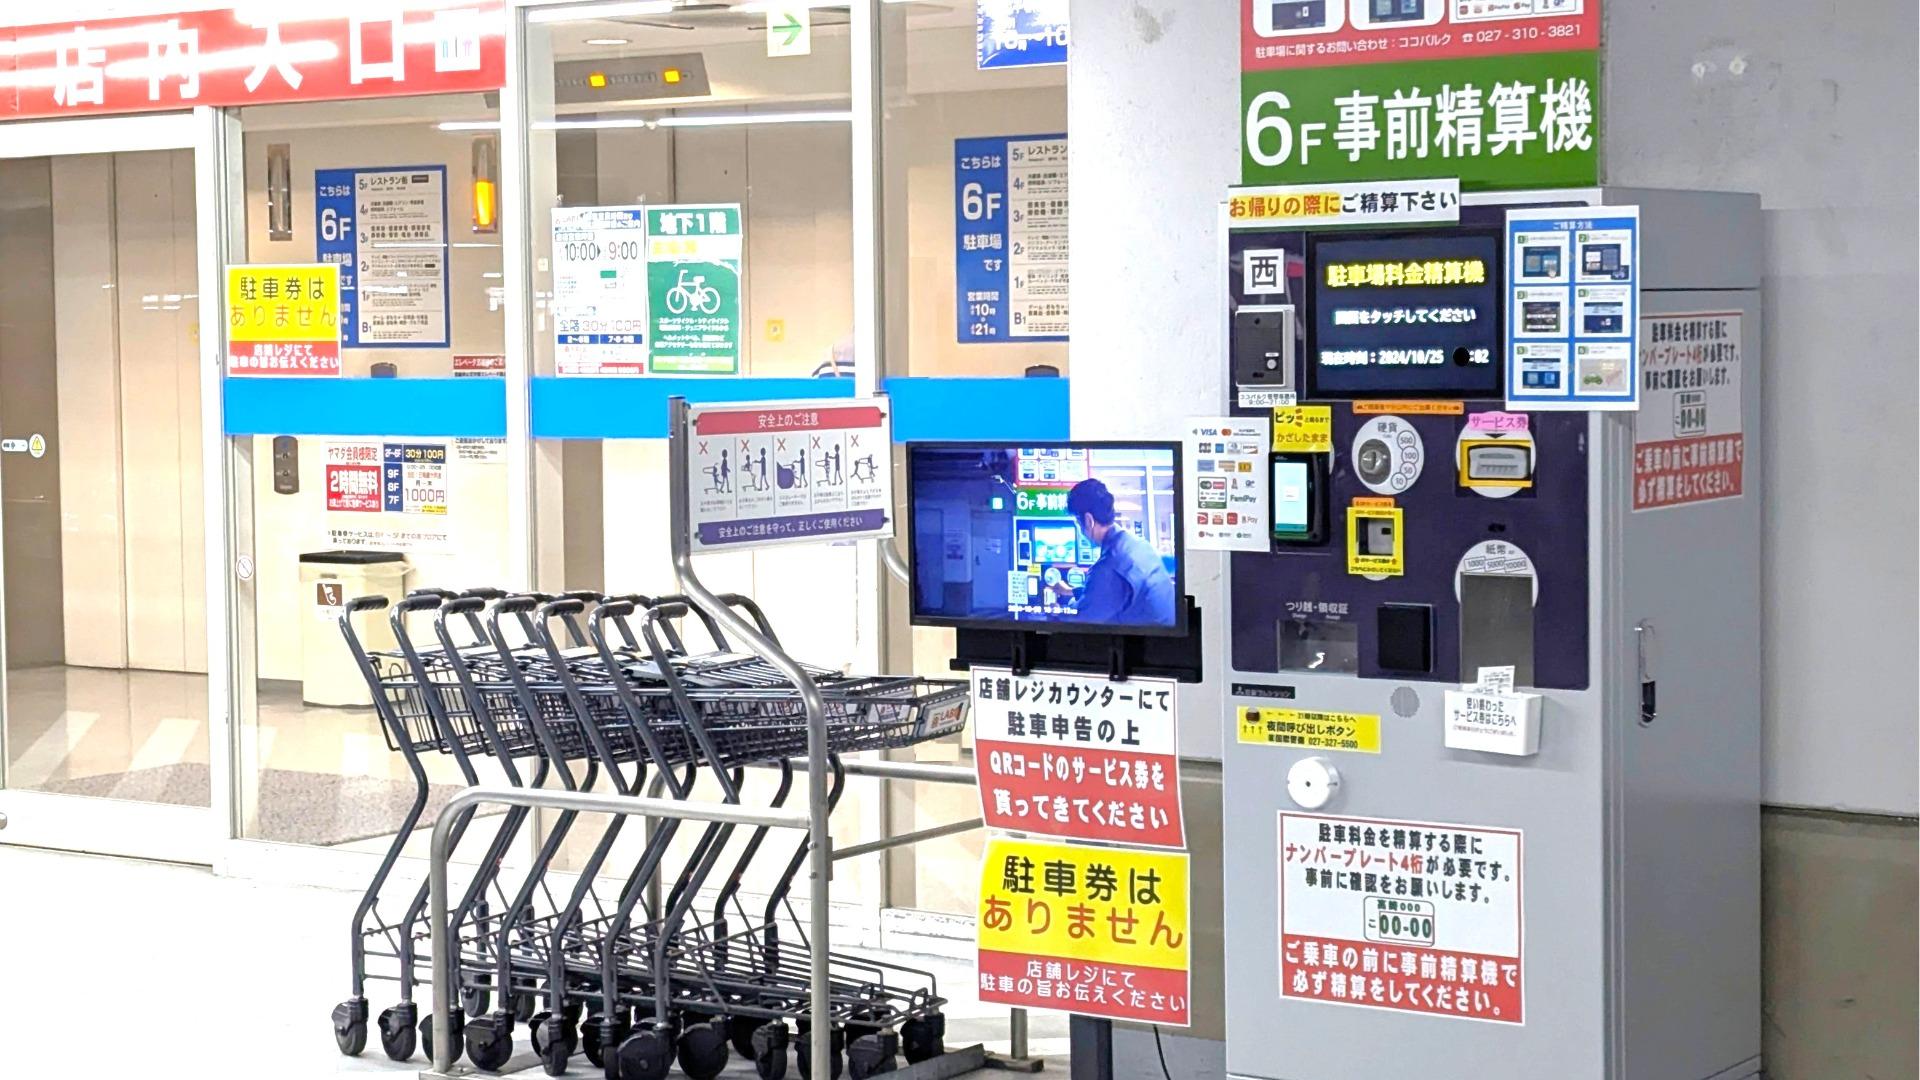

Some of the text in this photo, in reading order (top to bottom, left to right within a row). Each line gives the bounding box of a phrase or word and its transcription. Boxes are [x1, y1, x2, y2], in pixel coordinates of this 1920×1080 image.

[53, 16, 405, 107] 店内入口
[961, 156, 1002, 170] こちらは
[1012, 147, 1025, 161] 5F
[319, 185, 351, 197] こちらは
[1013, 177, 1025, 190] 4F
[962, 182, 1002, 221] 6F
[1229, 190, 1457, 219] お帰りの際にご精算下さい
[321, 208, 352, 241] 6F
[1013, 209, 1024, 223] 3F
[1552, 220, 1593, 230] ご精算方法
[565, 242, 596, 261] 10:00
[608, 241, 638, 260] 9:00
[963, 233, 1003, 251] 駐車場
[1013, 242, 1025, 255] 2F
[983, 258, 1003, 272] です
[1249, 256, 1279, 289] 西
[1326, 260, 1486, 288] 駐車場料金精算機
[240, 276, 325, 300] 駐車券は
[1014, 276, 1025, 289] 1F
[230, 304, 337, 327] ありません
[1014, 312, 1027, 325] B1
[1334, 308, 1477, 326] 画面をタッチしてください
[757, 412, 820, 429] 安全上のご注意
[1377, 422, 1398, 433] 硬貨
[1471, 416, 1528, 429] サービス券
[1200, 428, 1218, 436] VISA
[1276, 433, 1329, 443] かざしたまま
[1400, 437, 1413, 445] 500
[1404, 452, 1417, 460] 100
[404, 488, 445, 503] 1000円
[1285, 600, 1349, 615] つり銭・領収証
[979, 676, 1170, 712] 店舗レジカウンターにて
[1007, 710, 1140, 746] 駐車申告の上
[1267, 720, 1356, 738] 夜間呼び出しボタン
[989, 750, 1165, 792] QRコードのサービス券を
[993, 787, 1169, 830] 貰ってきてください
[1318, 822, 1484, 856] 駐車料金を精算する際に
[1285, 842, 1510, 883] ナンバープレート4桁が必要です。
[1002, 855, 1162, 904] 駐車券は
[1304, 866, 1490, 904] 事前に確認をお願いします。
[983, 894, 1184, 949] ありません
[1379, 913, 1433, 939] 00-00
[1285, 939, 1518, 988] ご乗車の前に事前精算機で
[1026, 959, 1137, 989] 店舗レジにて
[980, 972, 1186, 1012] 駐車の旨お伝えください
[1292, 968, 1502, 1016] 必ず精算をしてください。
